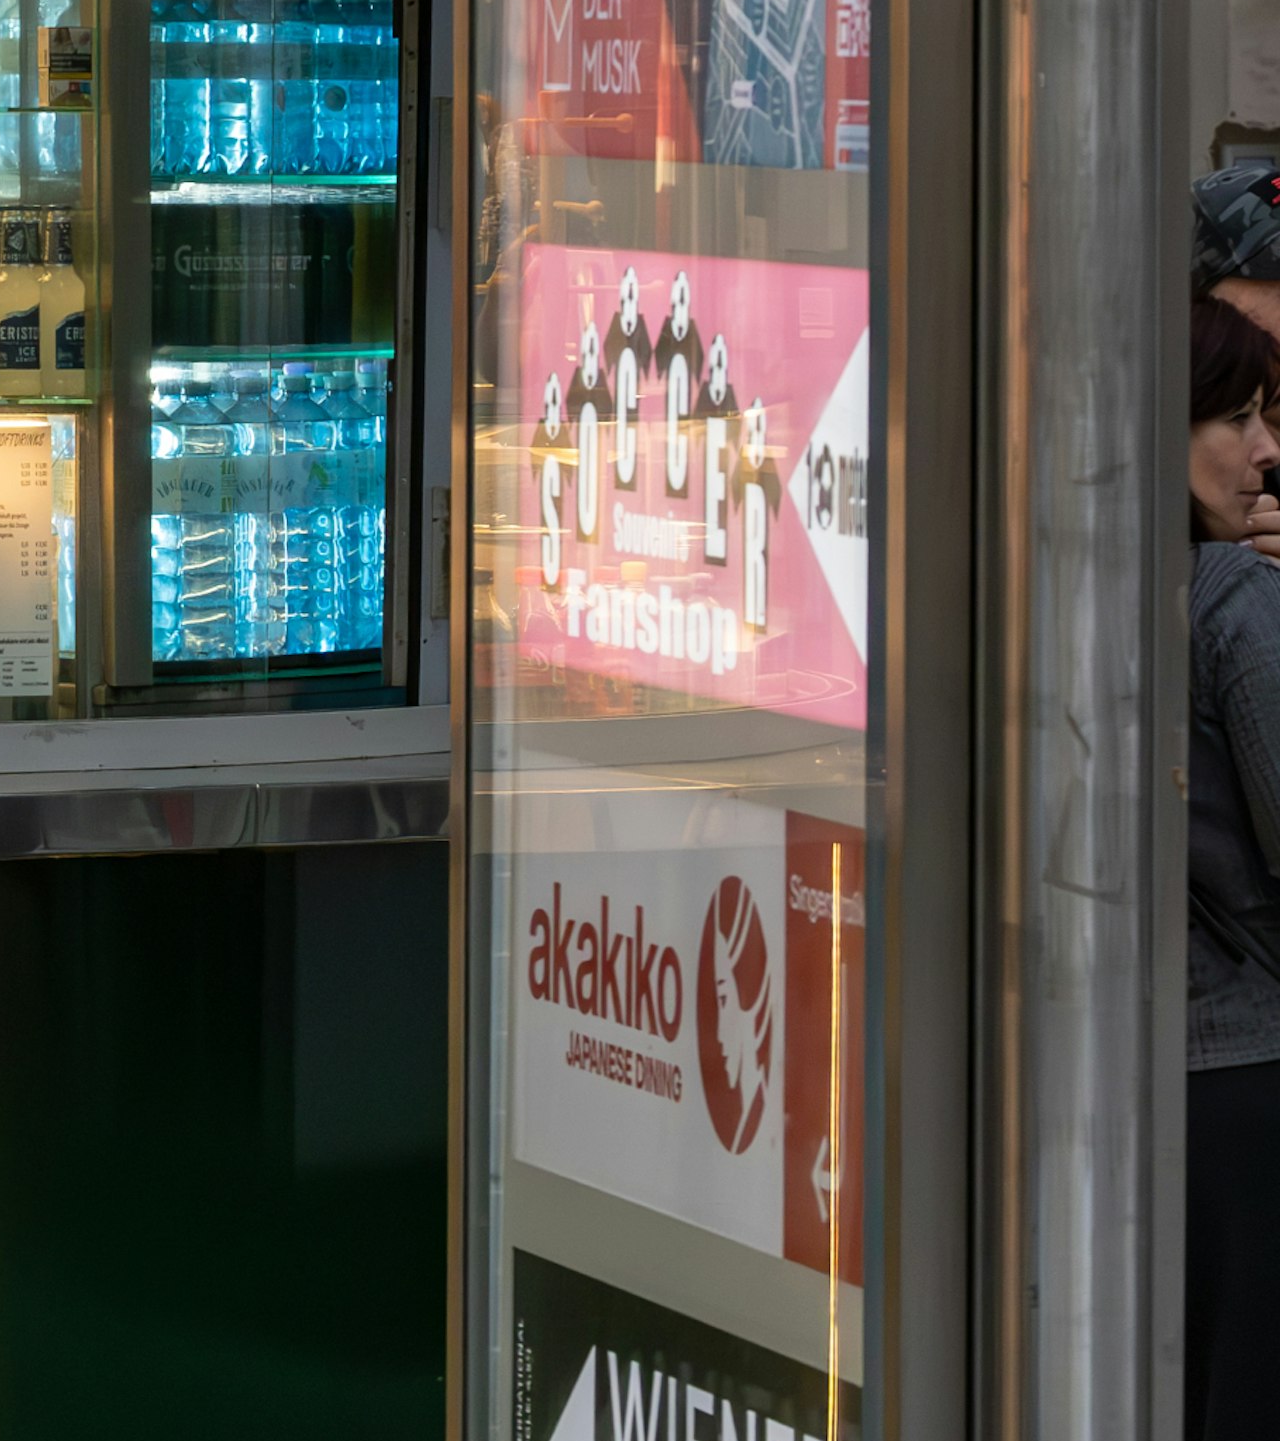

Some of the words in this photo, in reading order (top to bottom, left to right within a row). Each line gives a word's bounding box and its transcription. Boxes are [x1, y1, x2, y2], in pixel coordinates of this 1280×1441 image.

[581, 39, 643, 96] MUSIK
[541, 346, 768, 628] SOCCER
[567, 568, 738, 676] Fanshop
[527, 881, 684, 1044] akakiko
[565, 1029, 634, 1087] JAPANESE
[635, 1053, 684, 1103] DINING
